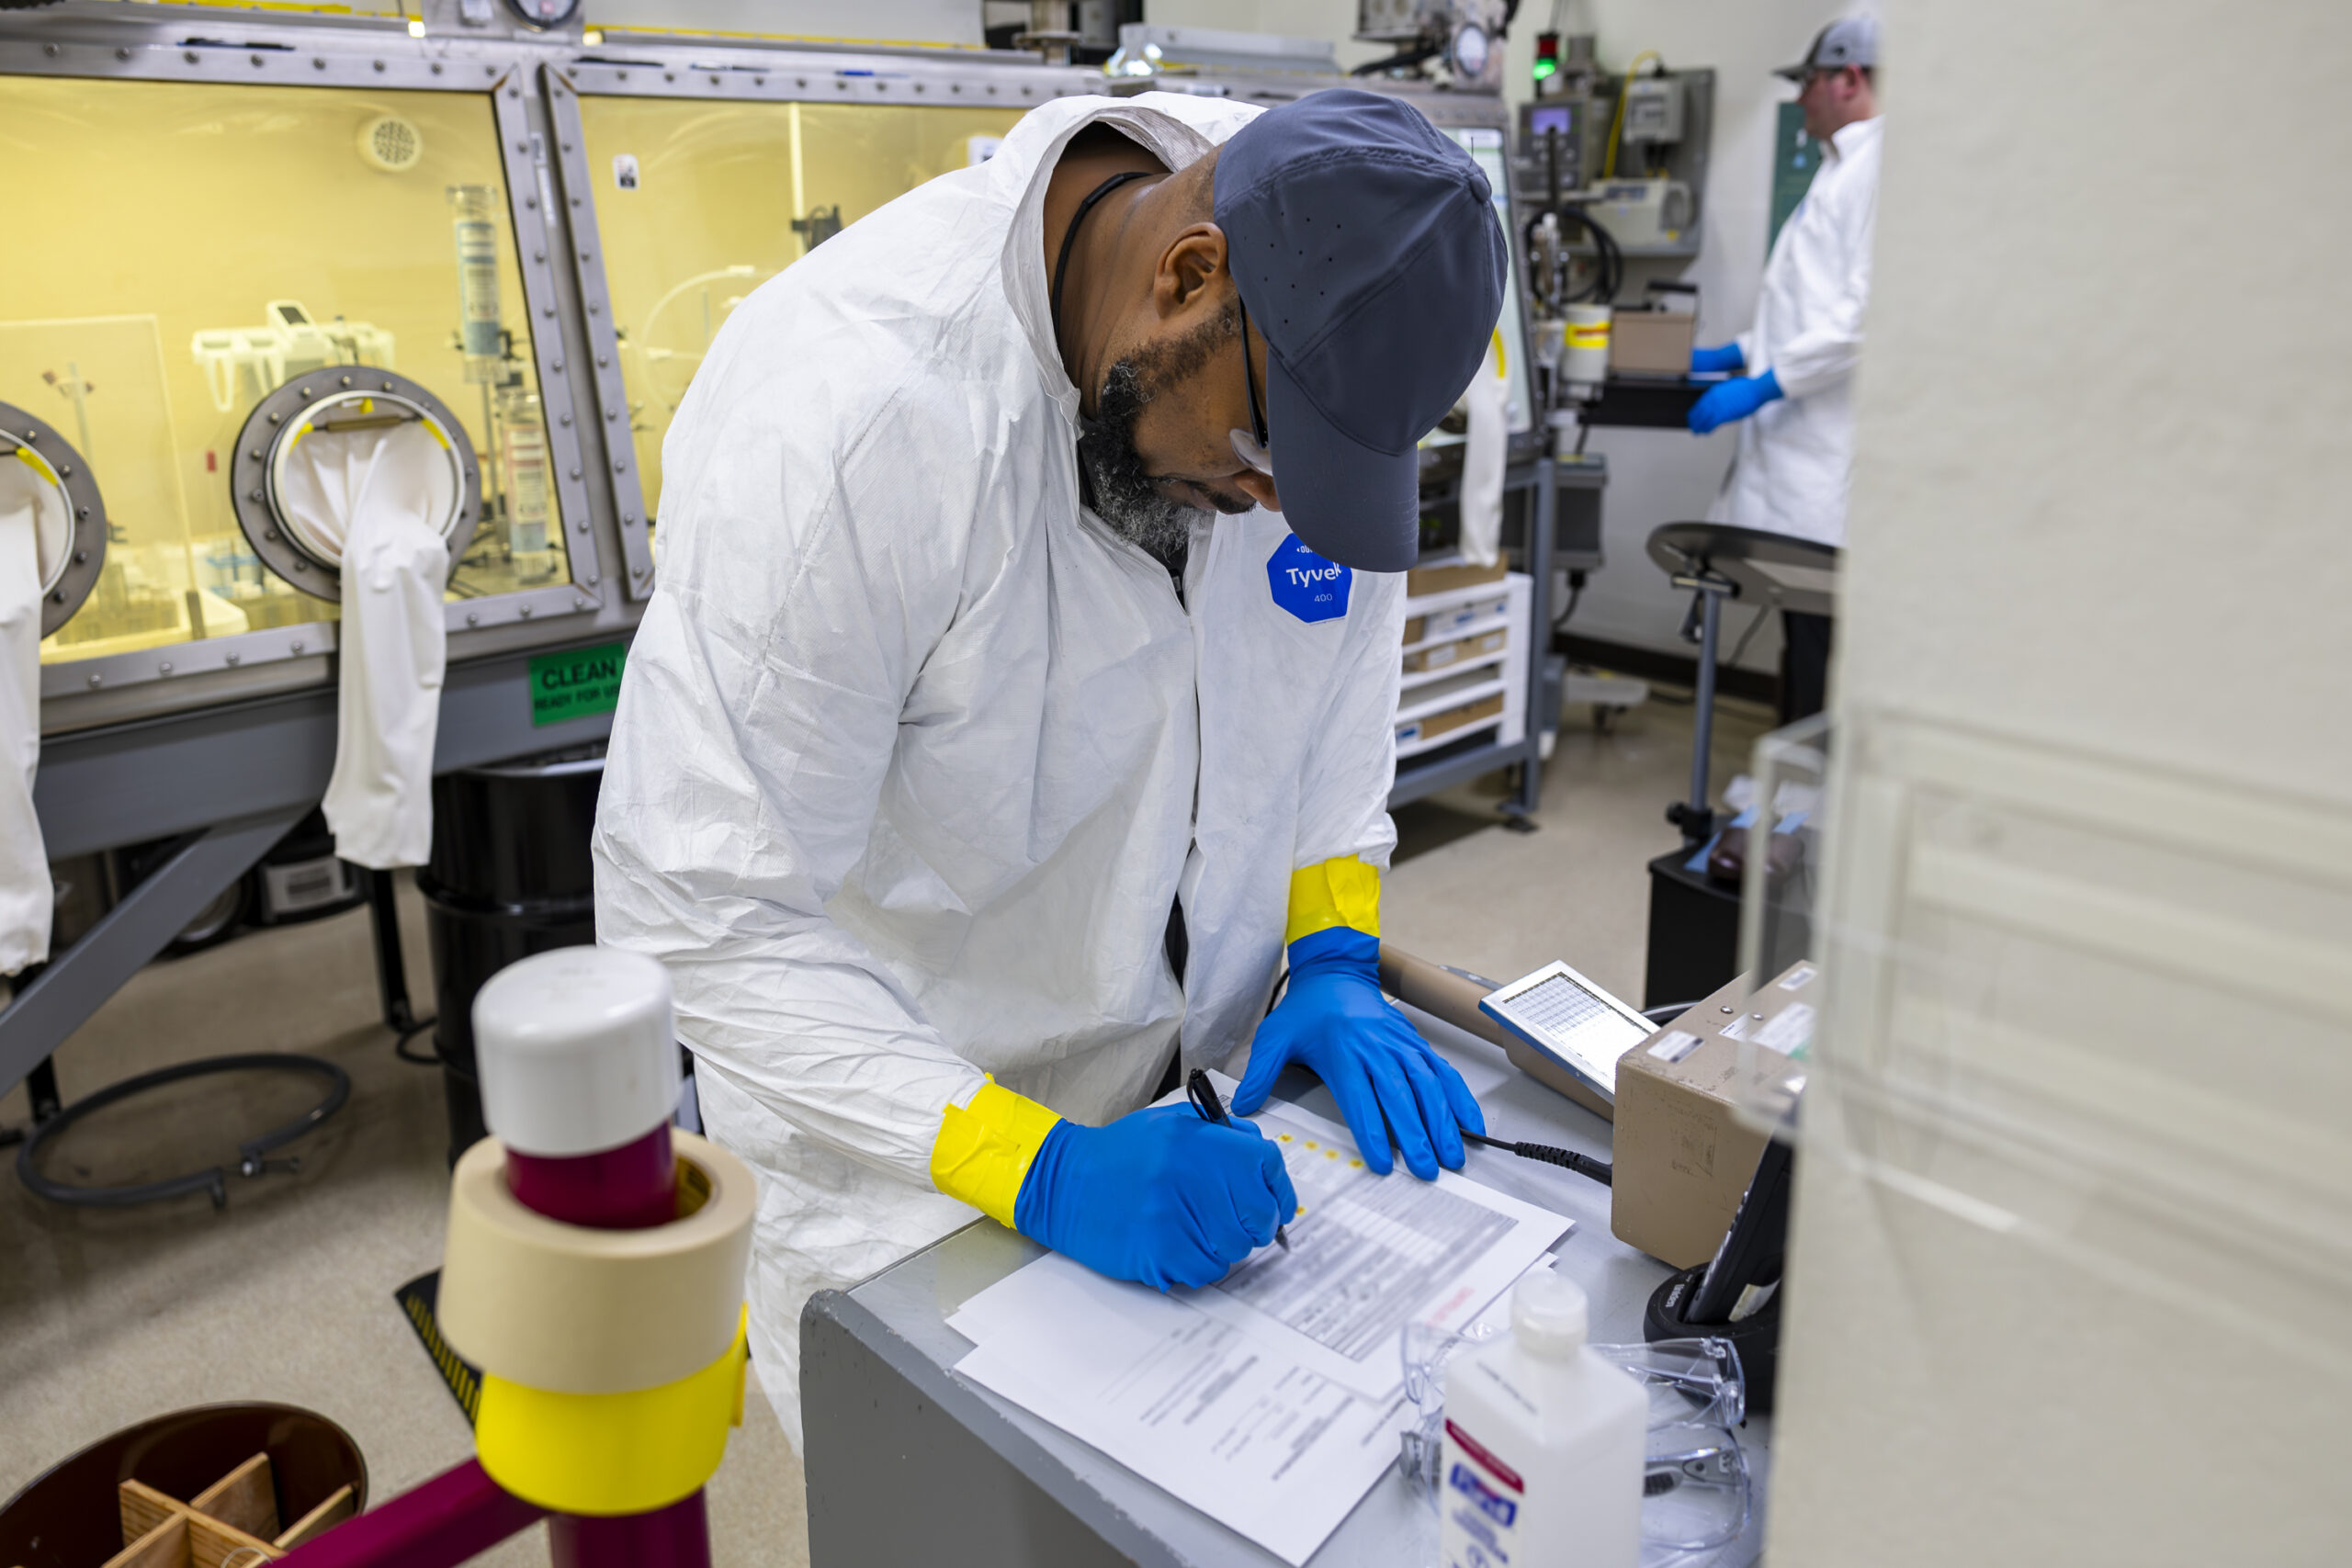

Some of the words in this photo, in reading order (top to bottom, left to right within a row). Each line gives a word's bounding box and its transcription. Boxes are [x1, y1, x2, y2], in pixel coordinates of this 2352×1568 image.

[1285, 561, 1341, 588] Tyvek
[1314, 592, 1333, 603] 400
[542, 659, 616, 690] CLEAN
[535, 694, 571, 709] READY
[576, 688, 600, 702] FOR
